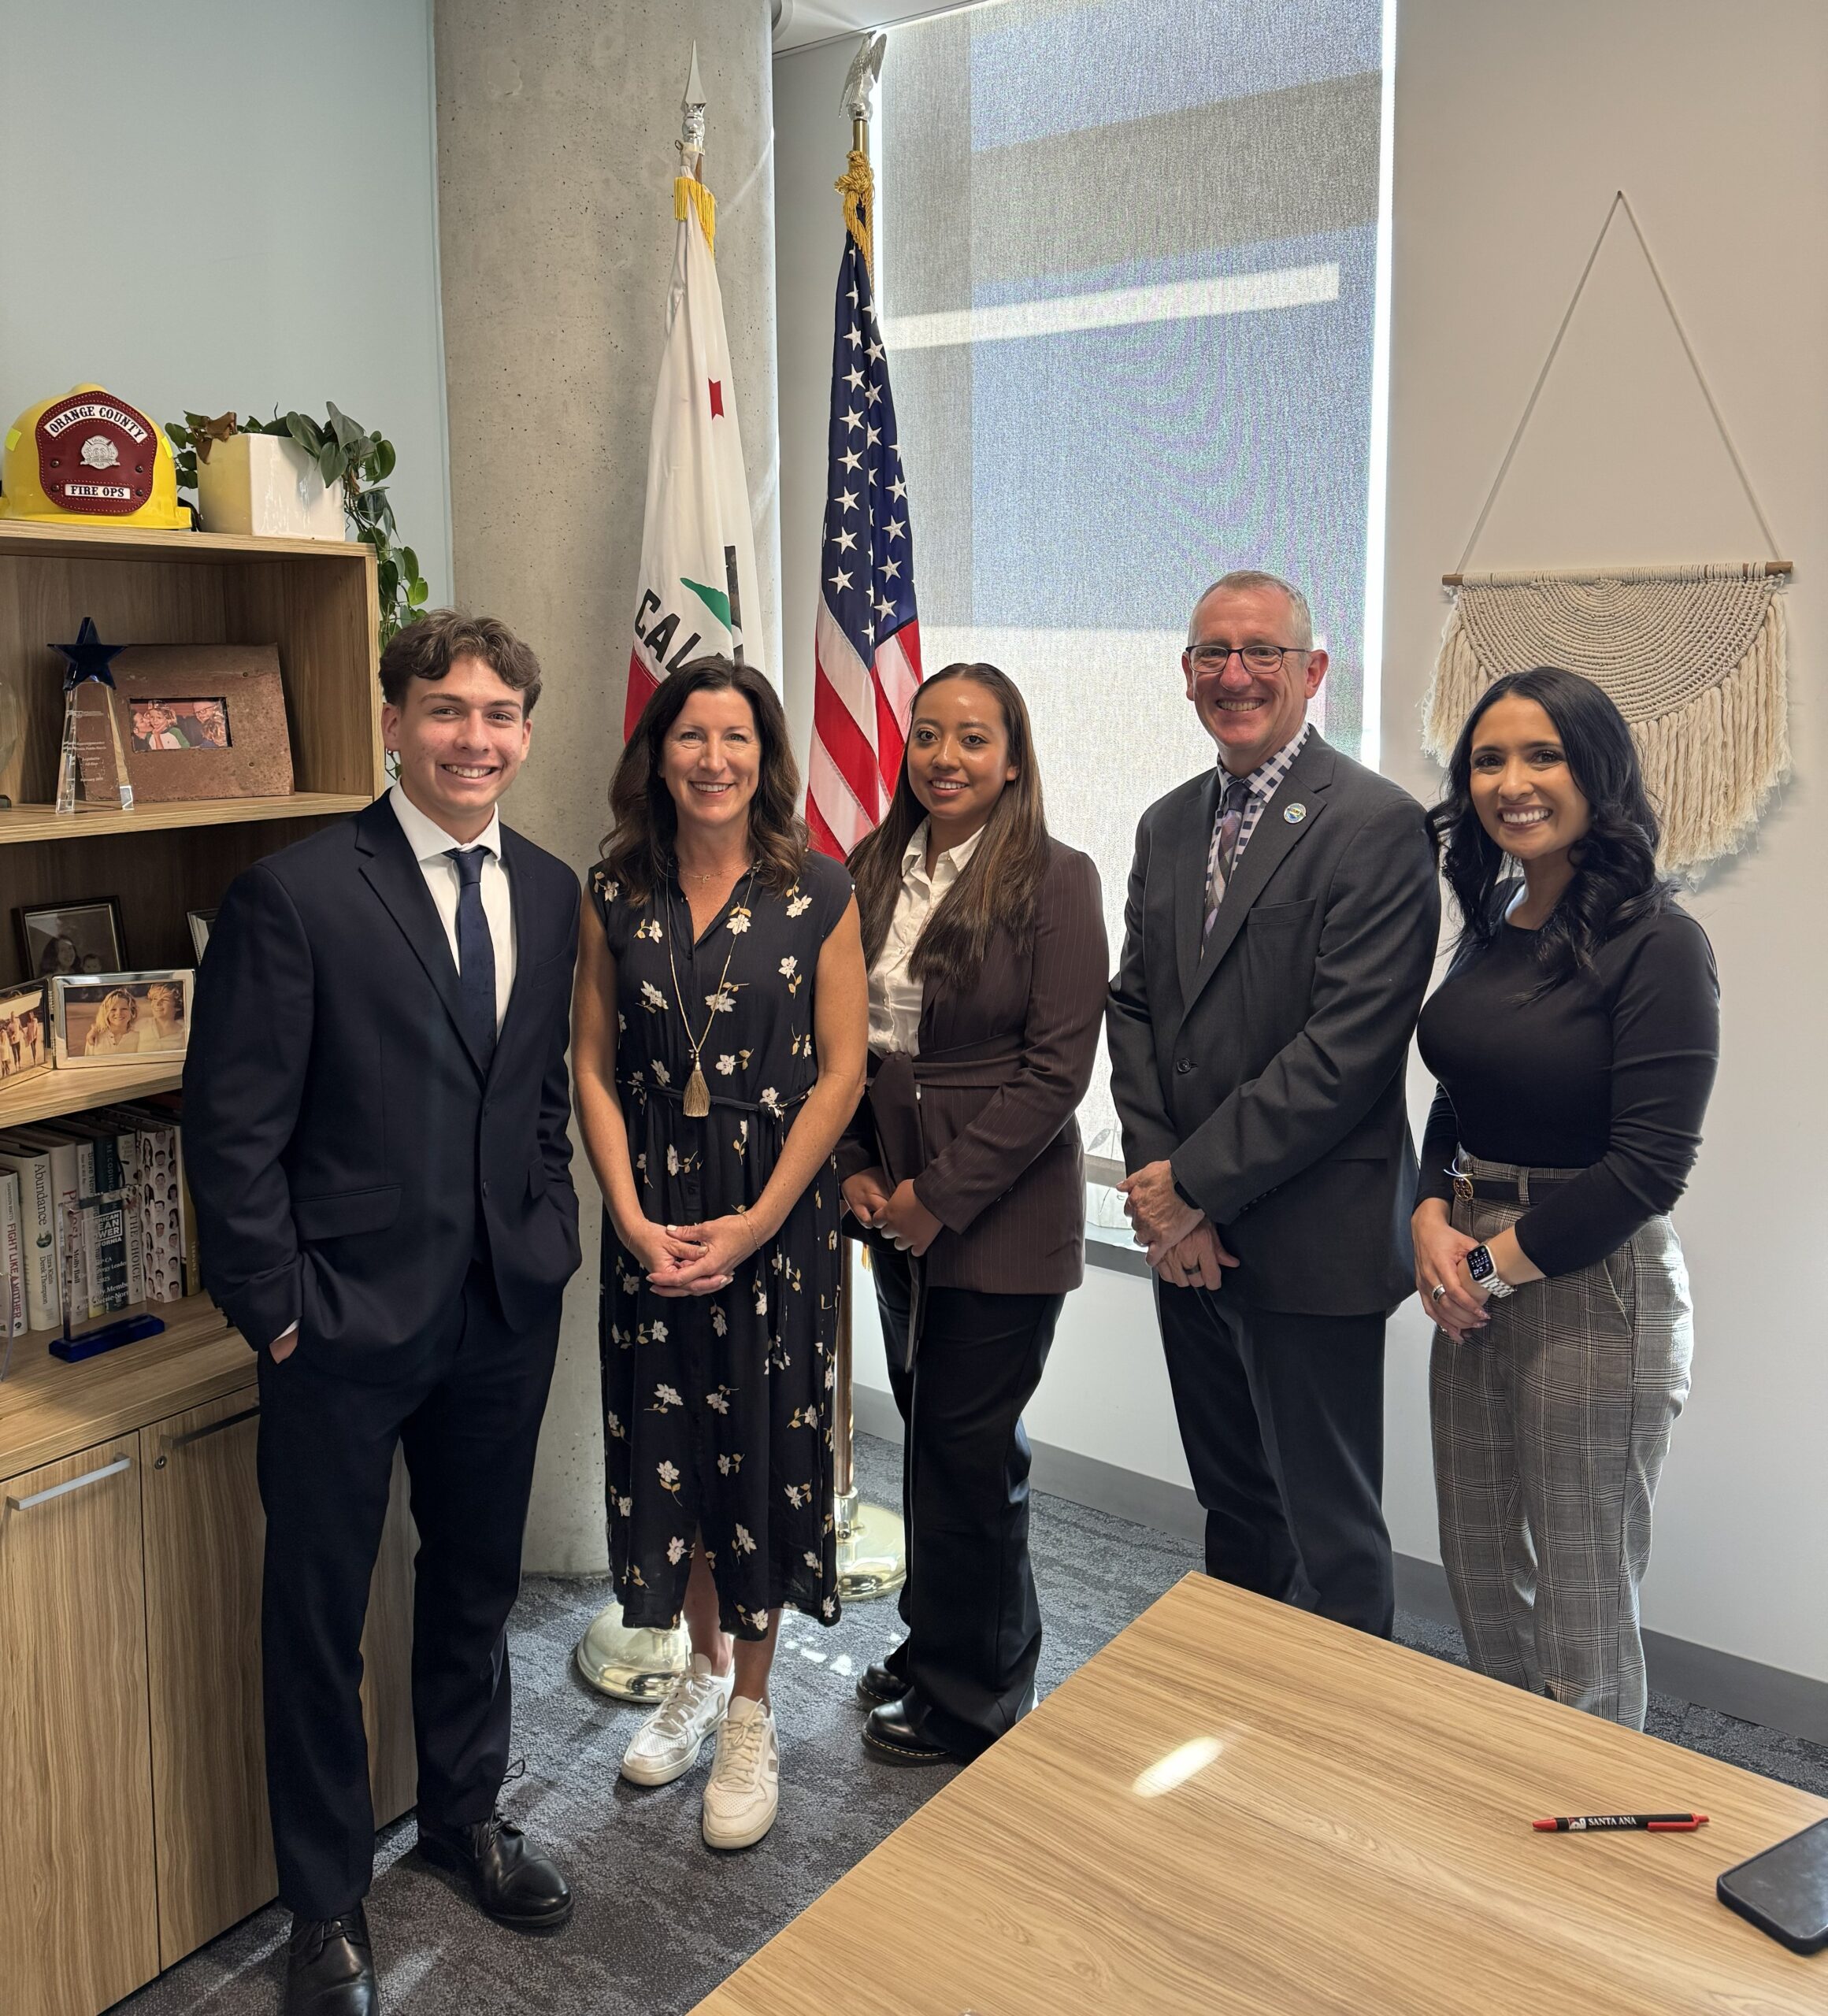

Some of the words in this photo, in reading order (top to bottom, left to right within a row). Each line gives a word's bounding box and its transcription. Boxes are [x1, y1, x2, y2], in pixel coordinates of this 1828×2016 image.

[50, 406, 95, 433] ORANGE
[98, 407, 144, 439] COUNTY
[71, 485, 98, 495] FIRE
[102, 487, 124, 497] OPS
[635, 588, 724, 674] CAL
[35, 1164, 47, 1226] Abundance
[62, 1190, 81, 1238] Plosi
[129, 1216, 139, 1237] THE
[7, 1223, 17, 1252] FIGHT
[9, 1254, 18, 1273] LIKE
[131, 1240, 141, 1282] CHOICE
[106, 1280, 128, 1292] Membe
[1588, 1817, 1617, 1826] SANTA
[1618, 1816, 1637, 1825] ANA
